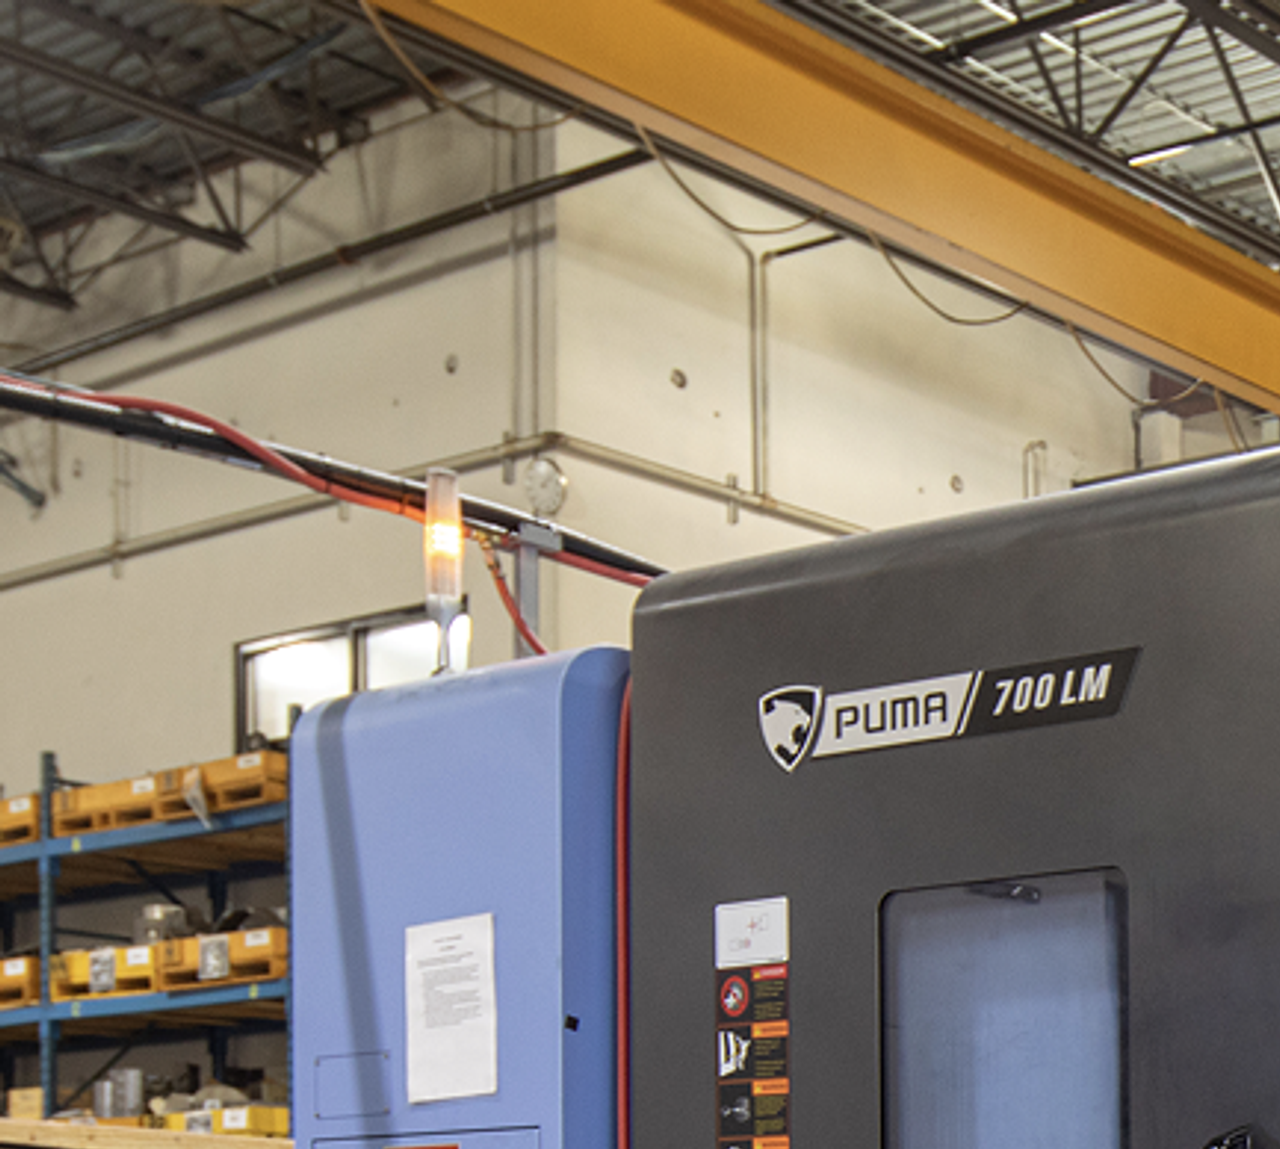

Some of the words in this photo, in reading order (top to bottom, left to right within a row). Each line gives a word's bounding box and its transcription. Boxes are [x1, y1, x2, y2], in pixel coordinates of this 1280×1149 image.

[834, 690, 948, 739] PUMA
[992, 673, 1056, 716] 700
[1060, 663, 1113, 706] LM
